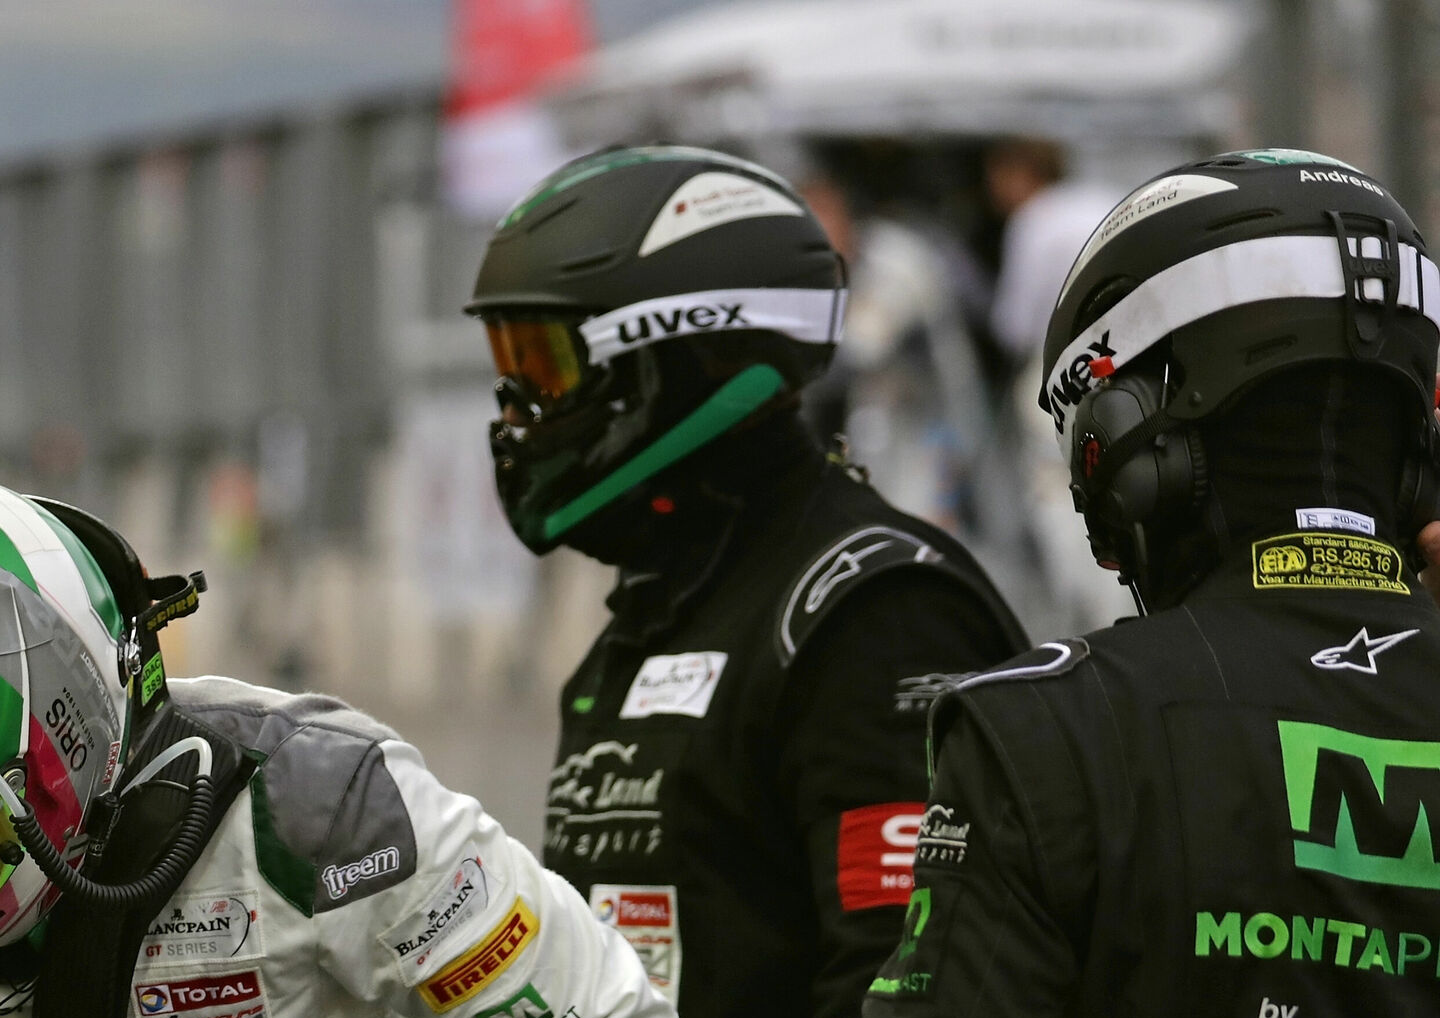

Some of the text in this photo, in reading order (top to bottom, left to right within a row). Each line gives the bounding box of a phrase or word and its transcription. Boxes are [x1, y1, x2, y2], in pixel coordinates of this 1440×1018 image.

[1300, 170, 1384, 196] Andreas
[1138, 189, 1178, 214] Land
[617, 302, 752, 345] uvex
[1303, 537, 1346, 548] Standard
[1262, 551, 1302, 572] FIA
[1312, 547, 1392, 574] RS.285.16
[1259, 575, 1286, 585] Year
[1288, 574, 1300, 584] of
[46, 698, 87, 772] ORIS
[323, 848, 399, 899] freem
[394, 880, 475, 957] BLANCPAIN
[146, 942, 218, 957] GT SERIES
[1194, 911, 1440, 977] MONTAP
[428, 913, 529, 1004] PIRELLI
[172, 982, 254, 1005] TOTAL
